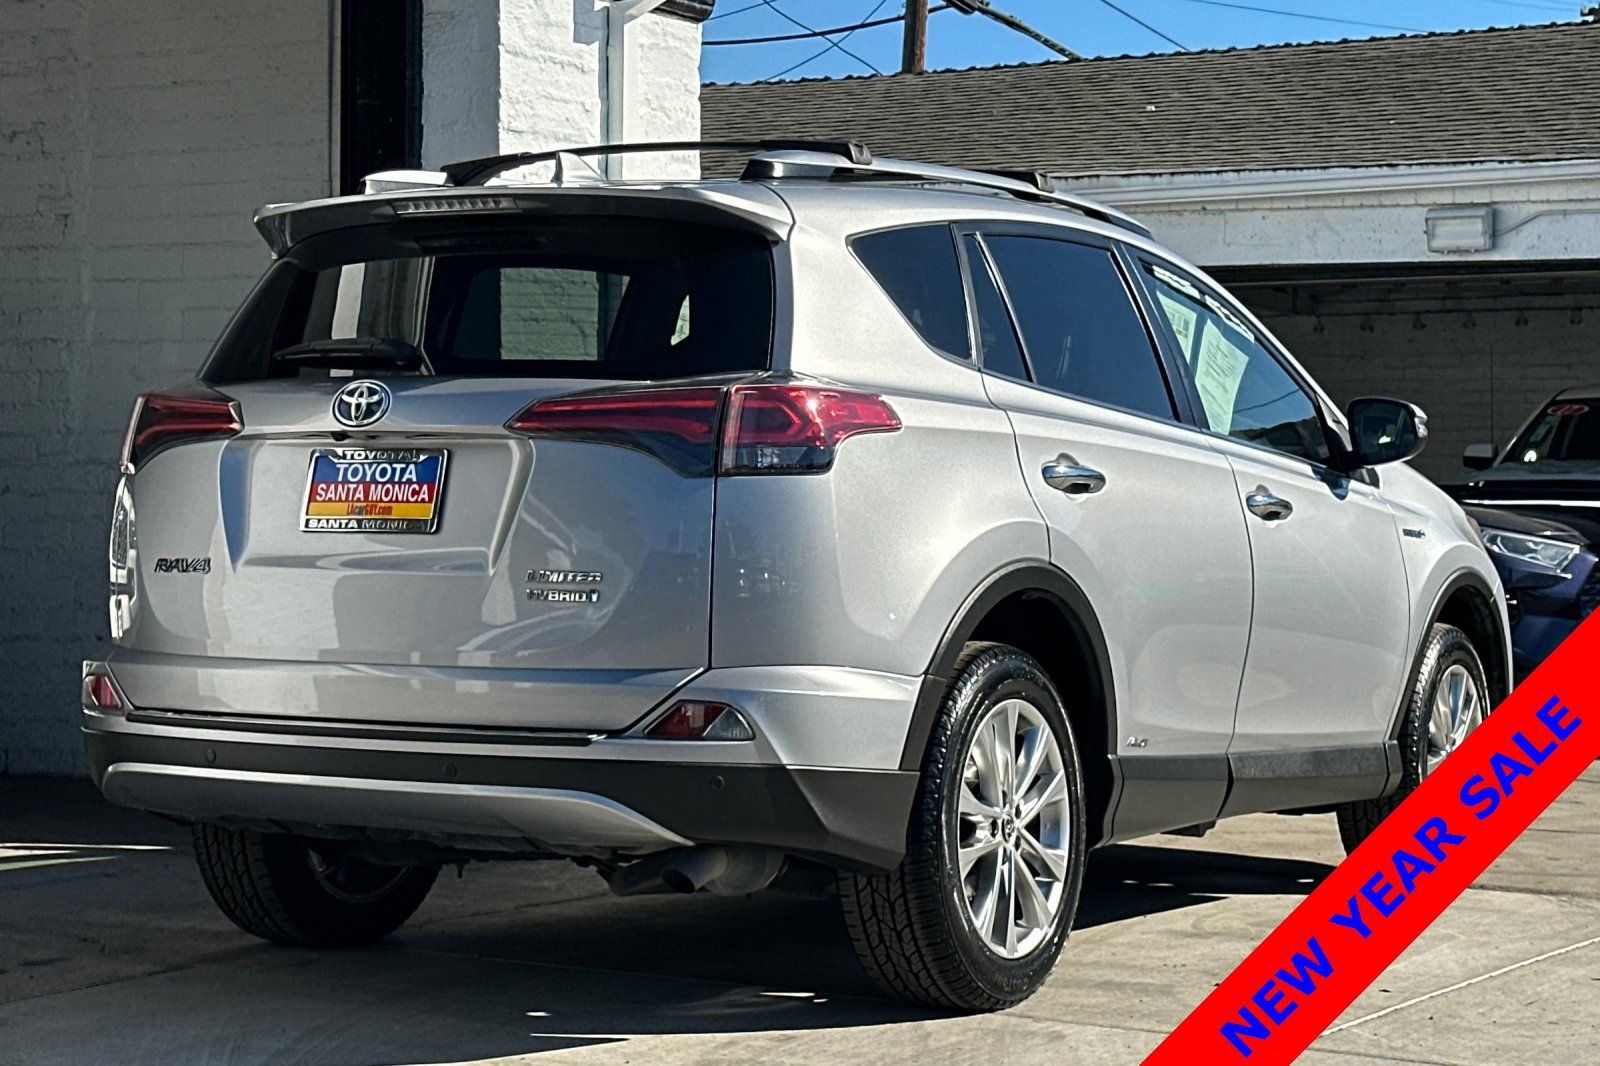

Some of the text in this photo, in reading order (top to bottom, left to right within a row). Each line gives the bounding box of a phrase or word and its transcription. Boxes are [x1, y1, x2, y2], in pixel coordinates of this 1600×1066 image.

[344, 450, 411, 461] TOYOTA
[336, 463, 417, 482] TOYOTA
[316, 483, 429, 502] SANTA MONICA
[308, 519, 358, 529] SANTA
[154, 557, 212, 575] RAV4
[525, 569, 603, 584] LIMITED
[525, 588, 588, 602] HYBRID
